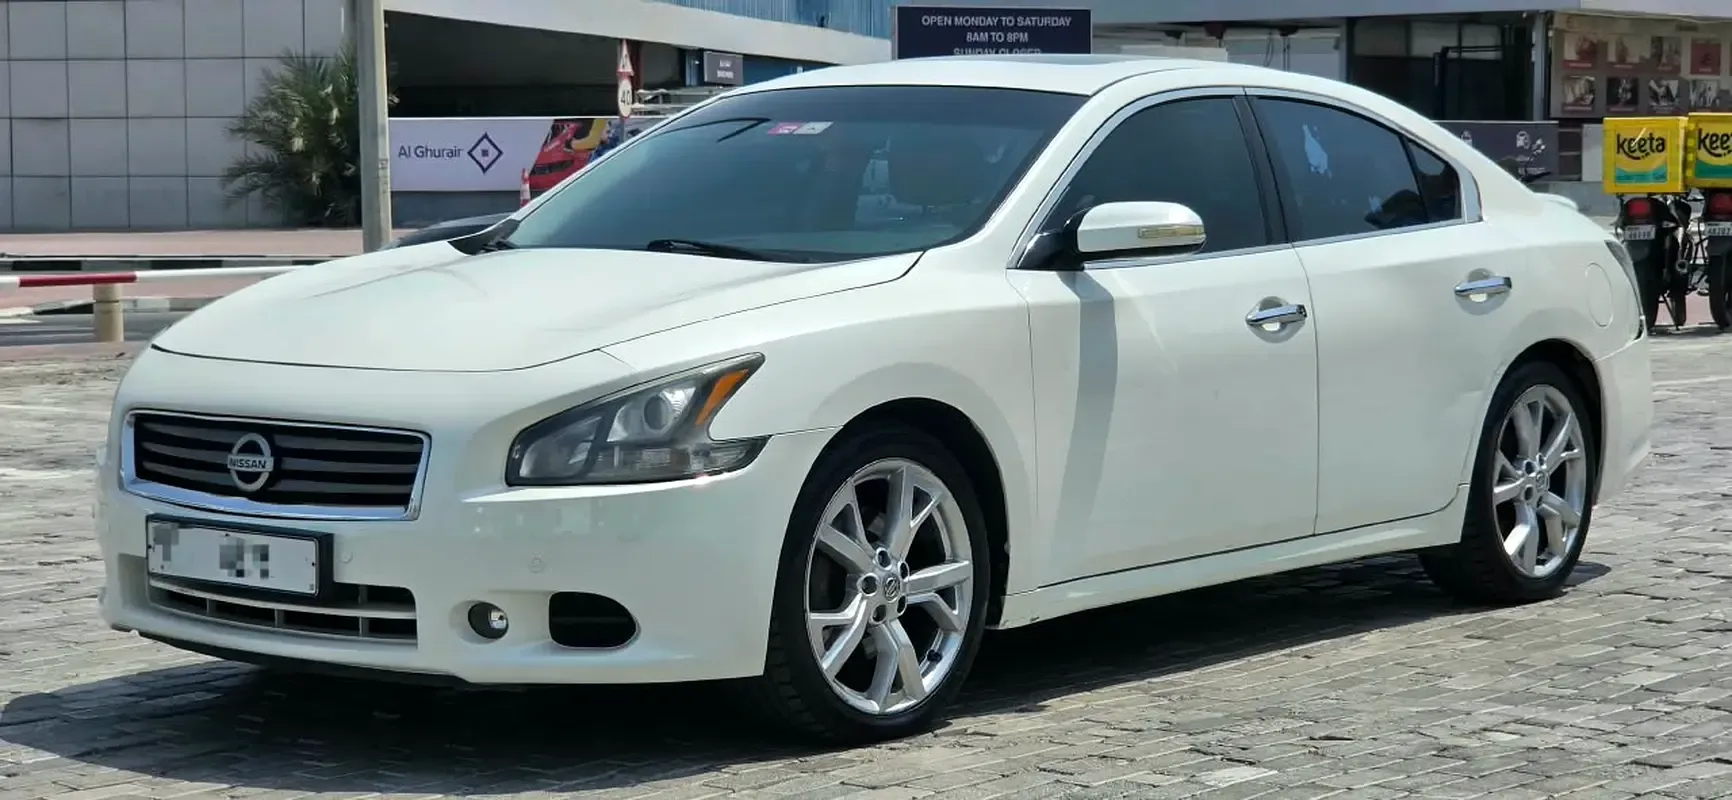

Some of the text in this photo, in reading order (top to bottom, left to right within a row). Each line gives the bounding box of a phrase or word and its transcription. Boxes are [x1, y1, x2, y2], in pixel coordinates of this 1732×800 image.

[921, 15, 1072, 27] OPEN MONDAY TO SATURDAY
[966, 31, 1029, 43] 8AM TO 8PM
[620, 88, 631, 106] 40
[1616, 131, 1667, 160] keeta
[1697, 127, 1732, 157] kee
[398, 144, 464, 158] Al Ghurair
[230, 457, 266, 469] NISSAN
